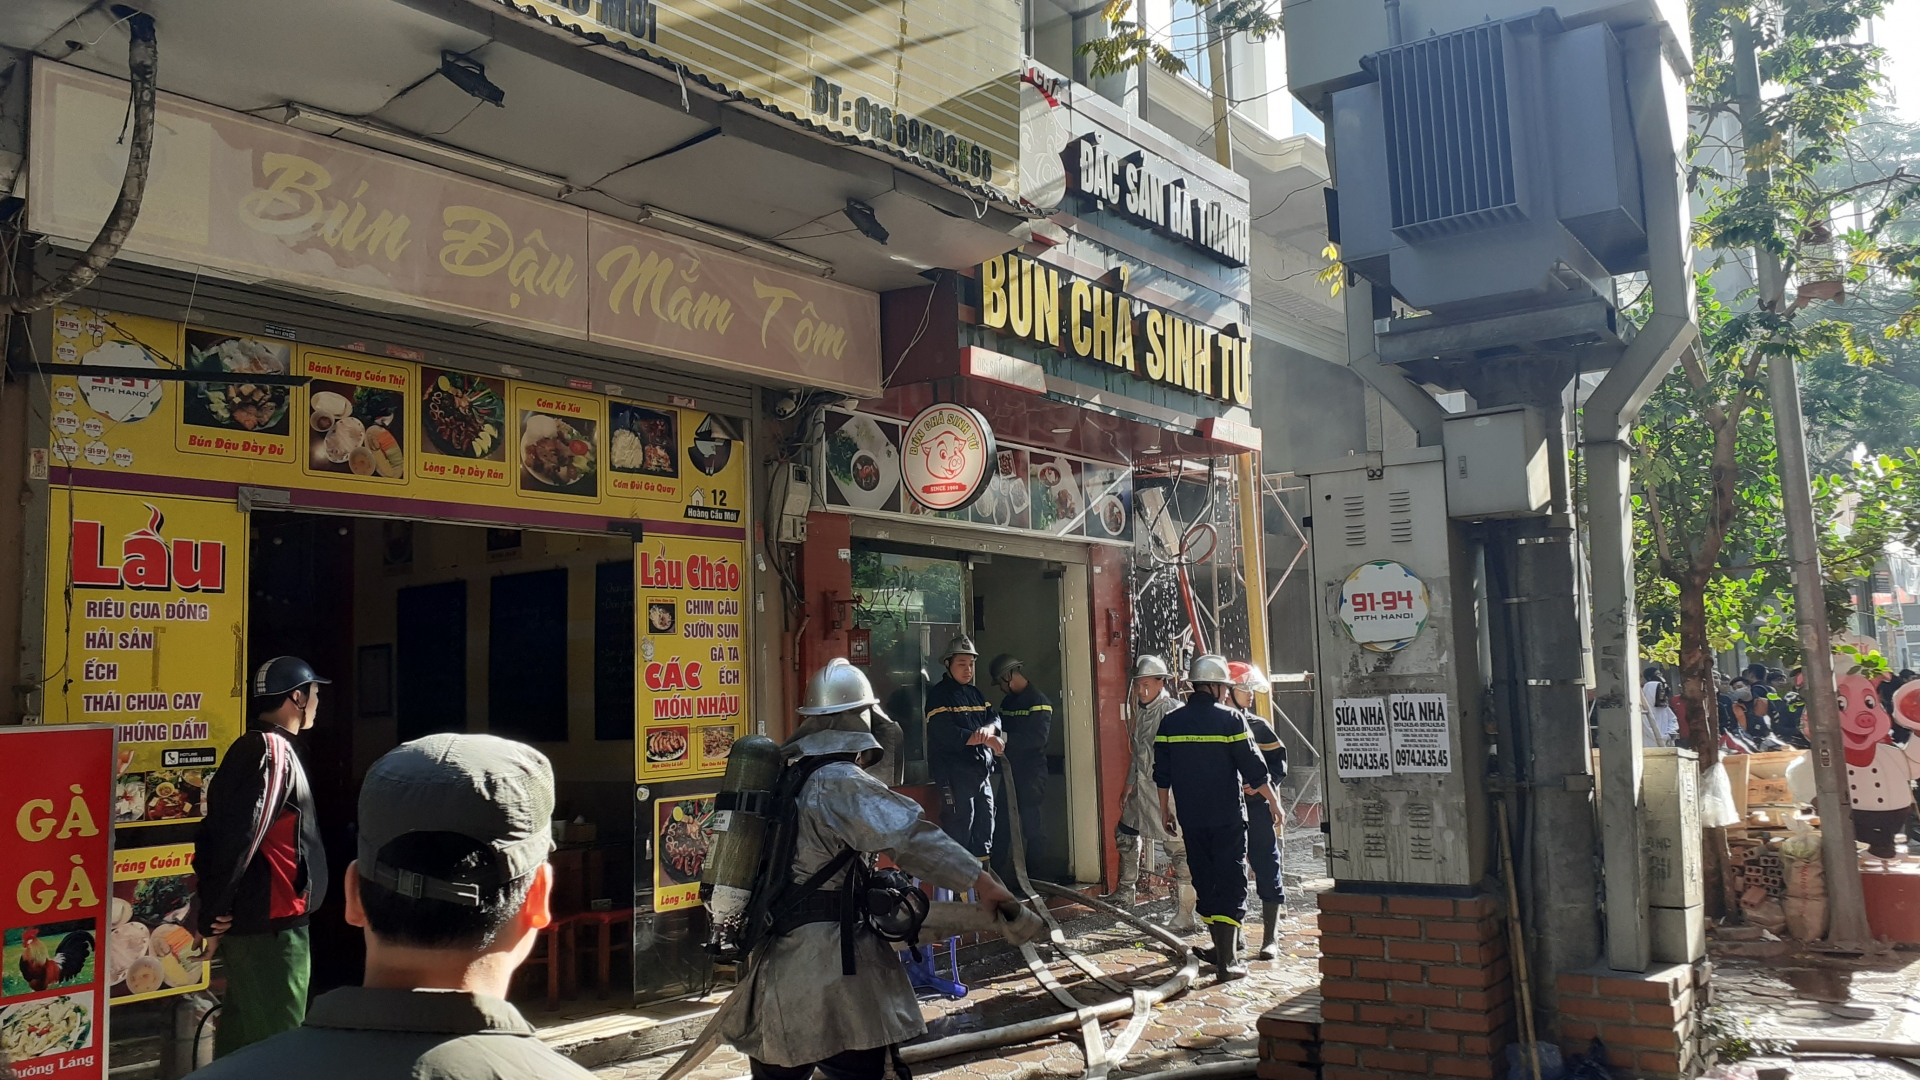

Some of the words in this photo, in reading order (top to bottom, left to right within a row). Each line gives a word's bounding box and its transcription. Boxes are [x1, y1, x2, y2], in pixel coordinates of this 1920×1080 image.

[1080, 132, 1120, 210] ĐẶC
[1125, 150, 1165, 227] SẢN
[1169, 177, 1193, 241] HÀ
[1197, 200, 1250, 266] THANH
[238, 151, 412, 261] Bún
[440, 205, 579, 309] Đậu
[753, 276, 848, 360] Tôm
[982, 244, 1059, 347] BÚN
[1070, 265, 1135, 372] CHẢ
[1145, 308, 1212, 396] SINH
[308, 361, 334, 375] Bánh
[335, 365, 362, 382] Tráng
[364, 369, 388, 383] Cuốn
[388, 372, 406, 388] Thịt
[91, 385, 115, 393] PTTH
[536, 398, 554, 410] Cơm
[555, 400, 567, 411] Xá
[567, 402, 581, 413] Xíu
[188, 435, 212, 448] Bún
[214, 438, 240, 453] Đậu
[241, 439, 266, 456] Đầy
[267, 442, 284, 456] Đủ
[909, 429, 926, 456] BÚN
[924, 411, 945, 431] CHẢ
[946, 413, 972, 435] SINH
[967, 433, 979, 450] TỪ
[423, 461, 446, 475] Lòng
[452, 465, 466, 479] Dạ
[467, 465, 486, 479] Dầy
[486, 469, 504, 479] Rán
[613, 478, 629, 490] Cơm
[644, 481, 656, 492] Gà
[657, 483, 676, 496] Quay
[711, 489, 727, 506] 12
[688, 507, 709, 520] Hoàng
[724, 510, 737, 521] Mới
[686, 555, 741, 591] Cháo
[85, 597, 126, 619] RIÊU
[129, 601, 162, 620] CUA
[165, 597, 210, 621] ĐỒNG
[685, 599, 715, 616] CHIM
[717, 597, 739, 616] CÂU
[1351, 590, 1413, 612] 91-94
[1353, 614, 1379, 622] PTTH
[1381, 612, 1414, 620] HANOI
[84, 626, 115, 650] HẢI
[118, 626, 153, 650] SẢN
[683, 620, 715, 639] SƯỜN
[716, 623, 740, 642] SỤN
[710, 644, 725, 662] GÀ
[727, 646, 740, 662] TA
[83, 657, 119, 681] ẾCH
[644, 656, 703, 691] CÁC
[718, 665, 740, 685] ẾCH
[83, 689, 122, 713] THÁI
[125, 693, 169, 711] CHUA
[173, 692, 202, 711] CAY
[653, 694, 694, 720] MÓN
[696, 692, 740, 721] NHẬU
[1335, 700, 1358, 726] SỬA
[1360, 702, 1386, 726] NHÀ
[1392, 695, 1417, 722] SỬA
[1418, 697, 1446, 721] NHÀ
[171, 716, 208, 740] DẤM
[16, 783, 99, 842] GÀ
[149, 852, 181, 870] Cuốn
[16, 854, 99, 914] GÀ
[660, 893, 680, 906] Lòng
[58, 1055, 95, 1071] Láng
